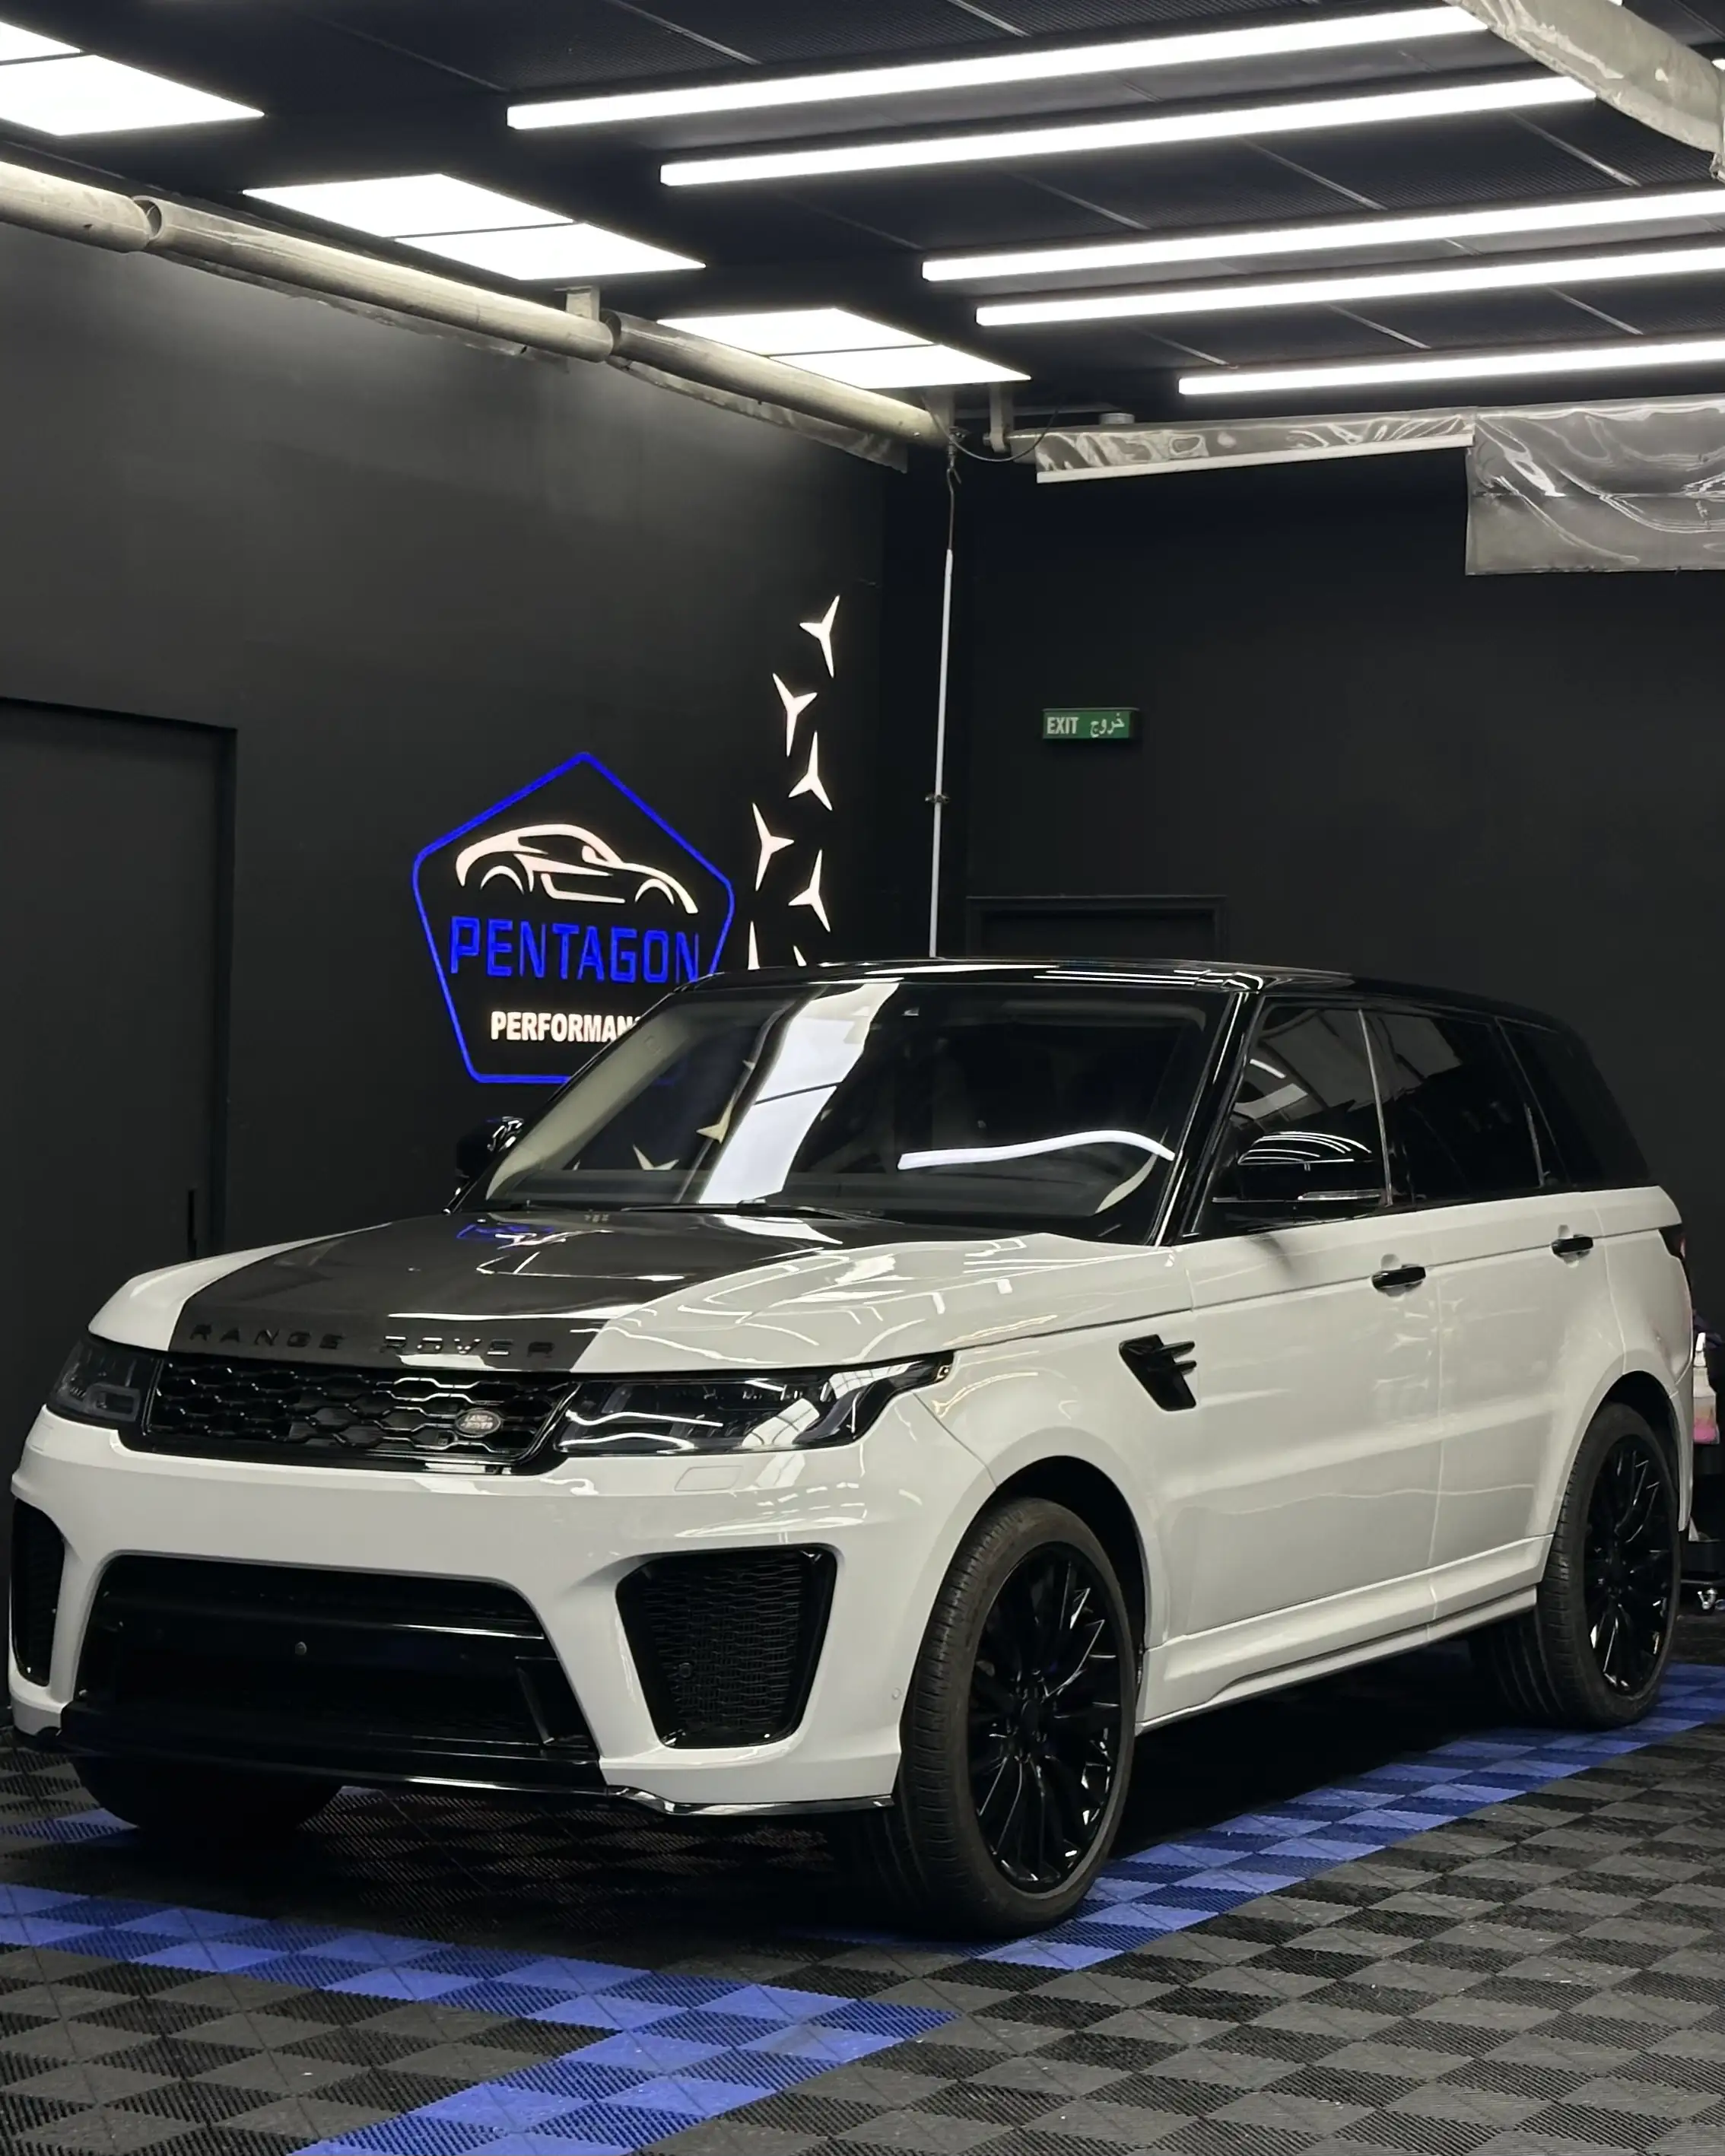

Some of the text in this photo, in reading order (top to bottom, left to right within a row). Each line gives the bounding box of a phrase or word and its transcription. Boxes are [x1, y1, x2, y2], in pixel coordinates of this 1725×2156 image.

[1047, 717, 1079, 734] EXIT
[1090, 713, 1125, 738] خروج
[450, 916, 699, 984] PENTAGON
[491, 1011, 641, 1043] PERFORMAN
[189, 1324, 555, 1357] RANGE ROVER
